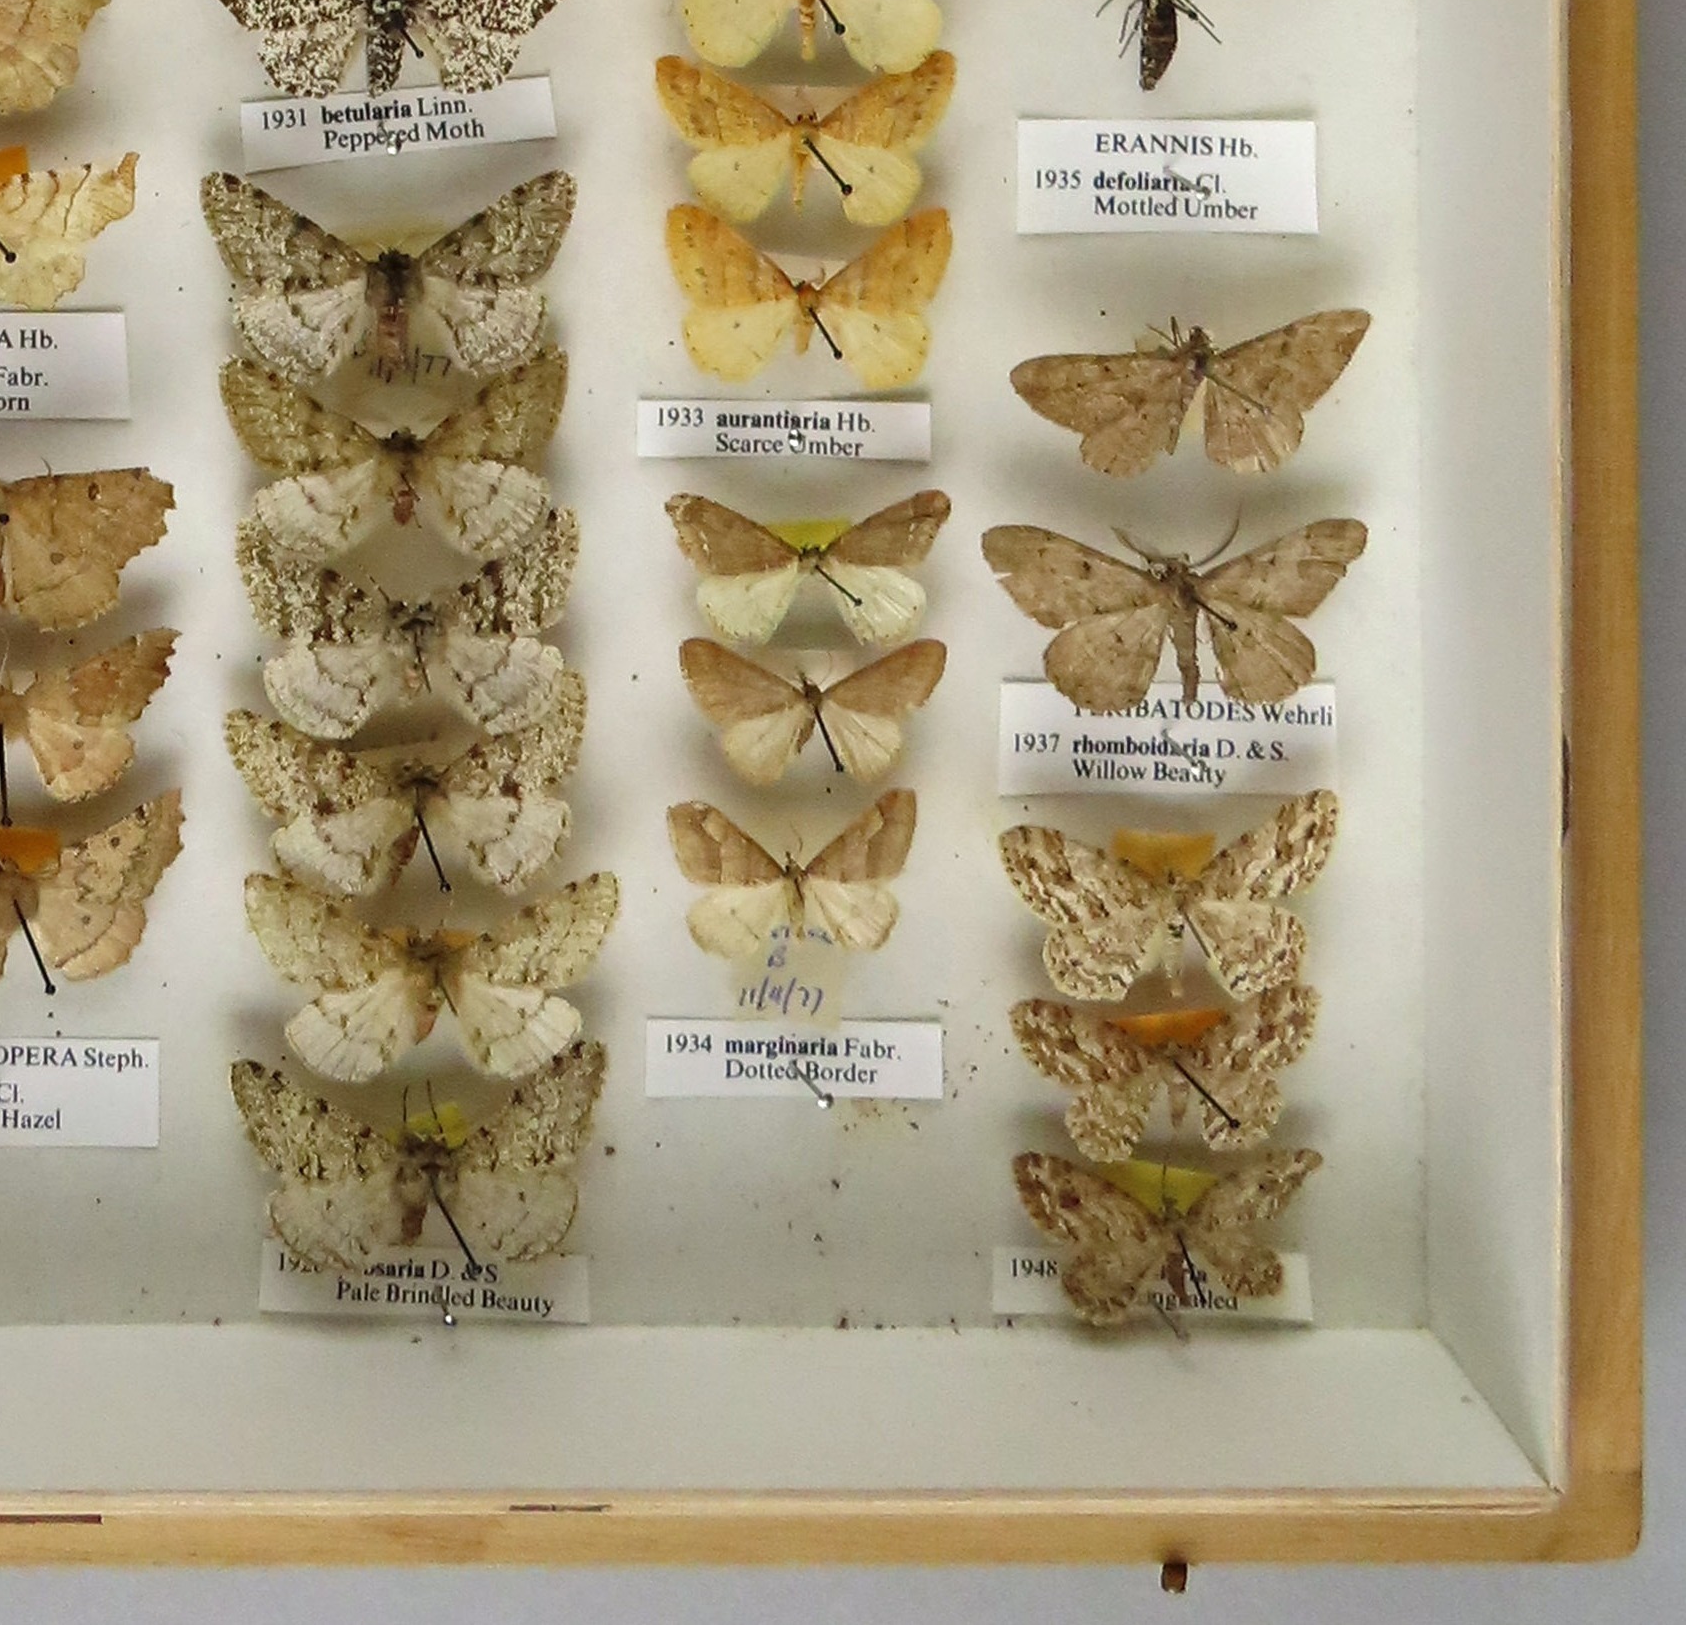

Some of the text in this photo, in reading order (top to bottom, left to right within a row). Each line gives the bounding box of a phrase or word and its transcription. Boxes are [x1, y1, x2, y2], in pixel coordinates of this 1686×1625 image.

[263, 97, 472, 130] 1931 betularia Linn.
[426, 118, 484, 141] Moth
[1096, 133, 1213, 155] ERANNIS
[1037, 170, 1081, 189] 1935
[1095, 195, 1258, 219] Mottled Umber
[20, 330, 57, 349] Hb.
[659, 407, 703, 427] 1933
[716, 433, 783, 453] Scarce
[1258, 700, 1332, 726] Wehrli
[1015, 733, 1060, 753] 1937
[1072, 759, 1147, 780] Willow
[667, 1034, 900, 1059] 1934 marginaria Fabr.
[84, 1047, 148, 1073] Steph.
[802, 1061, 877, 1087] Border
[2, 1108, 60, 1129] Hazel
[337, 1277, 553, 1317] Pale Beauty
